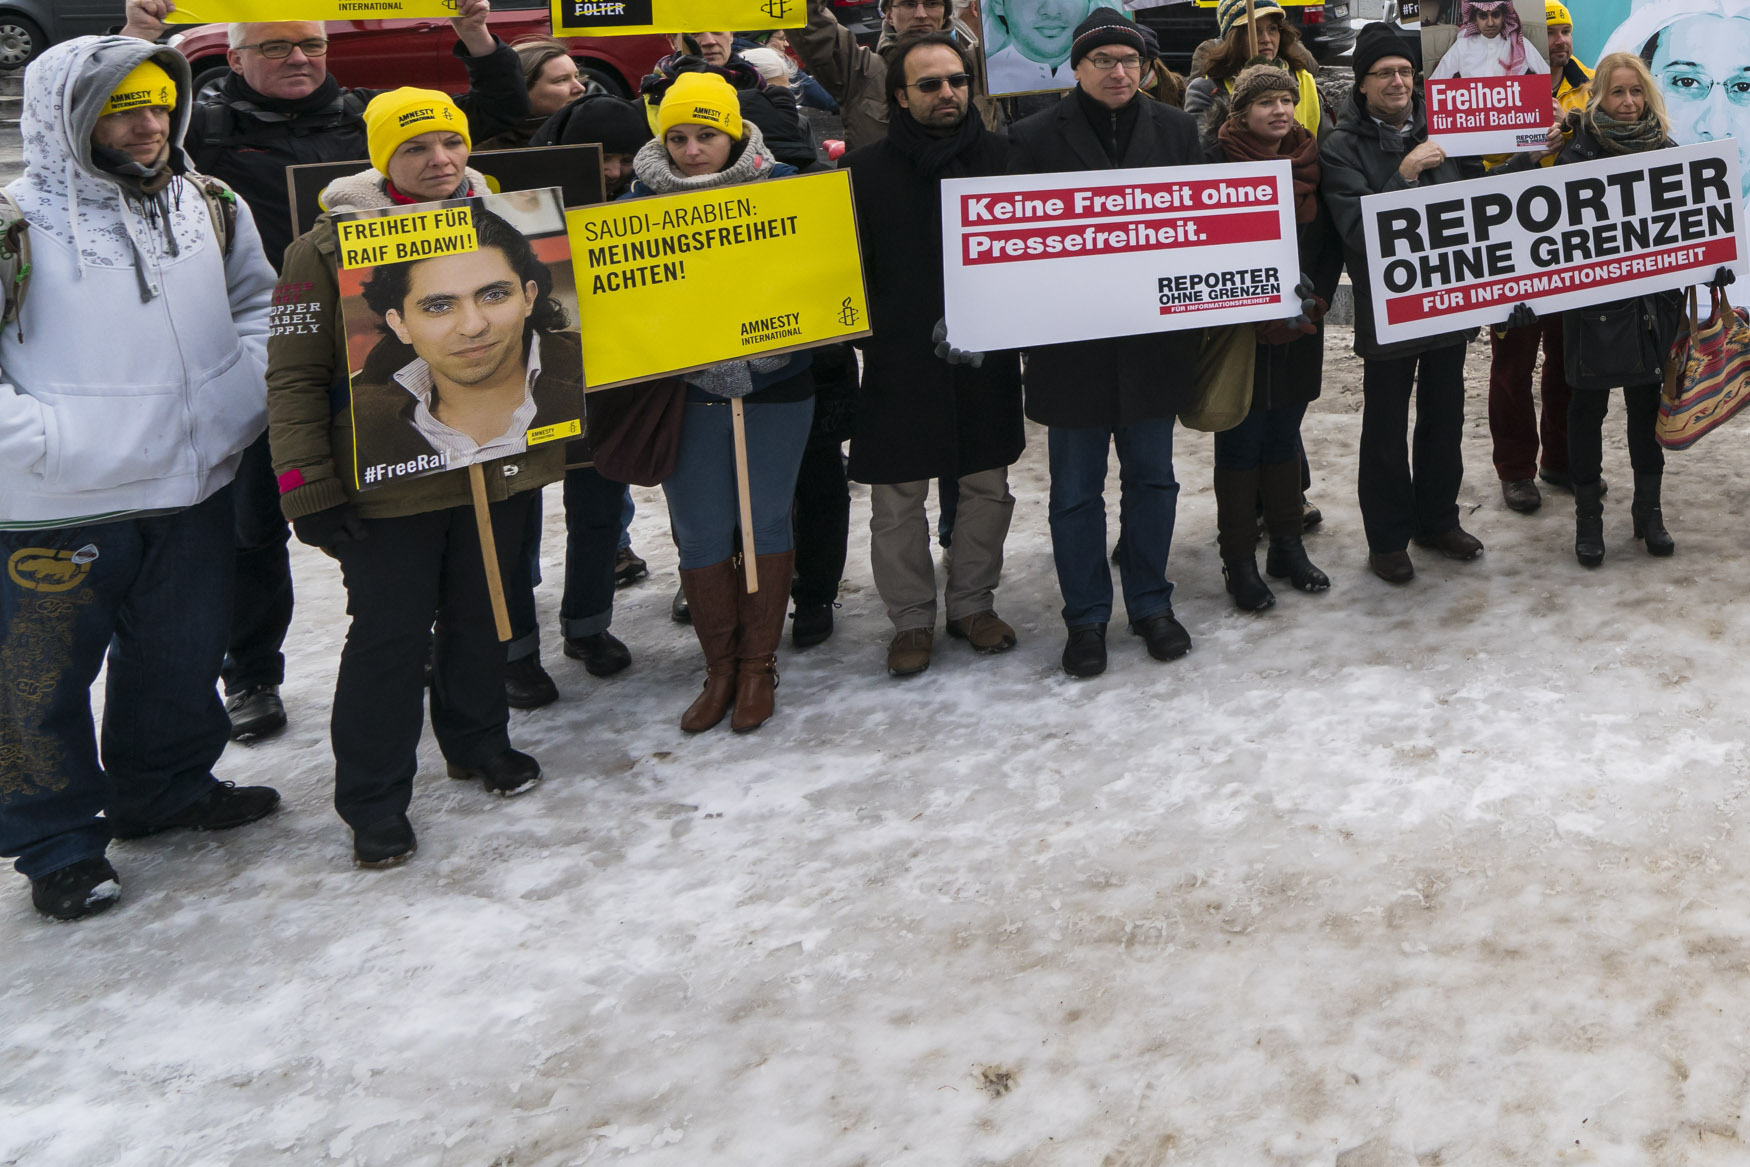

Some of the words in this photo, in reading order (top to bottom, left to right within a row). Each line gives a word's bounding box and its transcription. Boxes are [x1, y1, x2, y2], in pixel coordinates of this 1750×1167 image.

[338, 2, 403, 11] INTERNATIONAL
[575, 3, 625, 15] FOLTER
[111, 90, 151, 103] AMNESTY
[1431, 81, 1522, 111] Freiheit
[398, 108, 435, 124] AMNESTY
[693, 107, 721, 118] AMNESTY
[968, 195, 1064, 221] Keine
[1074, 186, 1192, 214] Freiheit
[1202, 182, 1273, 205] ohne
[1376, 157, 1731, 259] REPORTER
[343, 214, 427, 241] FREIHEIT
[434, 210, 469, 228] FÜR
[585, 198, 757, 242] SAUDI-ARABIEN:
[346, 246, 387, 266] RAIF
[396, 234, 474, 259] BADAWI!
[588, 216, 798, 268] MEINUNGSFREIHEIT
[969, 220, 1207, 259] Pressefreiheit.
[1383, 240, 1515, 293] OHNE
[1530, 202, 1734, 267] GRENZEN
[592, 260, 686, 295] ACHTEN!
[1158, 267, 1279, 294] REPORTER
[1422, 291, 1464, 312] FÜR
[1470, 247, 1706, 303] INFORMATIONSFREIHEIT
[1159, 290, 1203, 305] OHNE
[1208, 282, 1281, 300] GRENZEN
[1171, 304, 1185, 312] FÜR
[1187, 297, 1270, 311] INFORMATIONSFREIHEIT
[741, 312, 800, 336] AMNESTY
[742, 327, 802, 346] INTERNATIONAL
[364, 450, 452, 484] #FreeRaif
